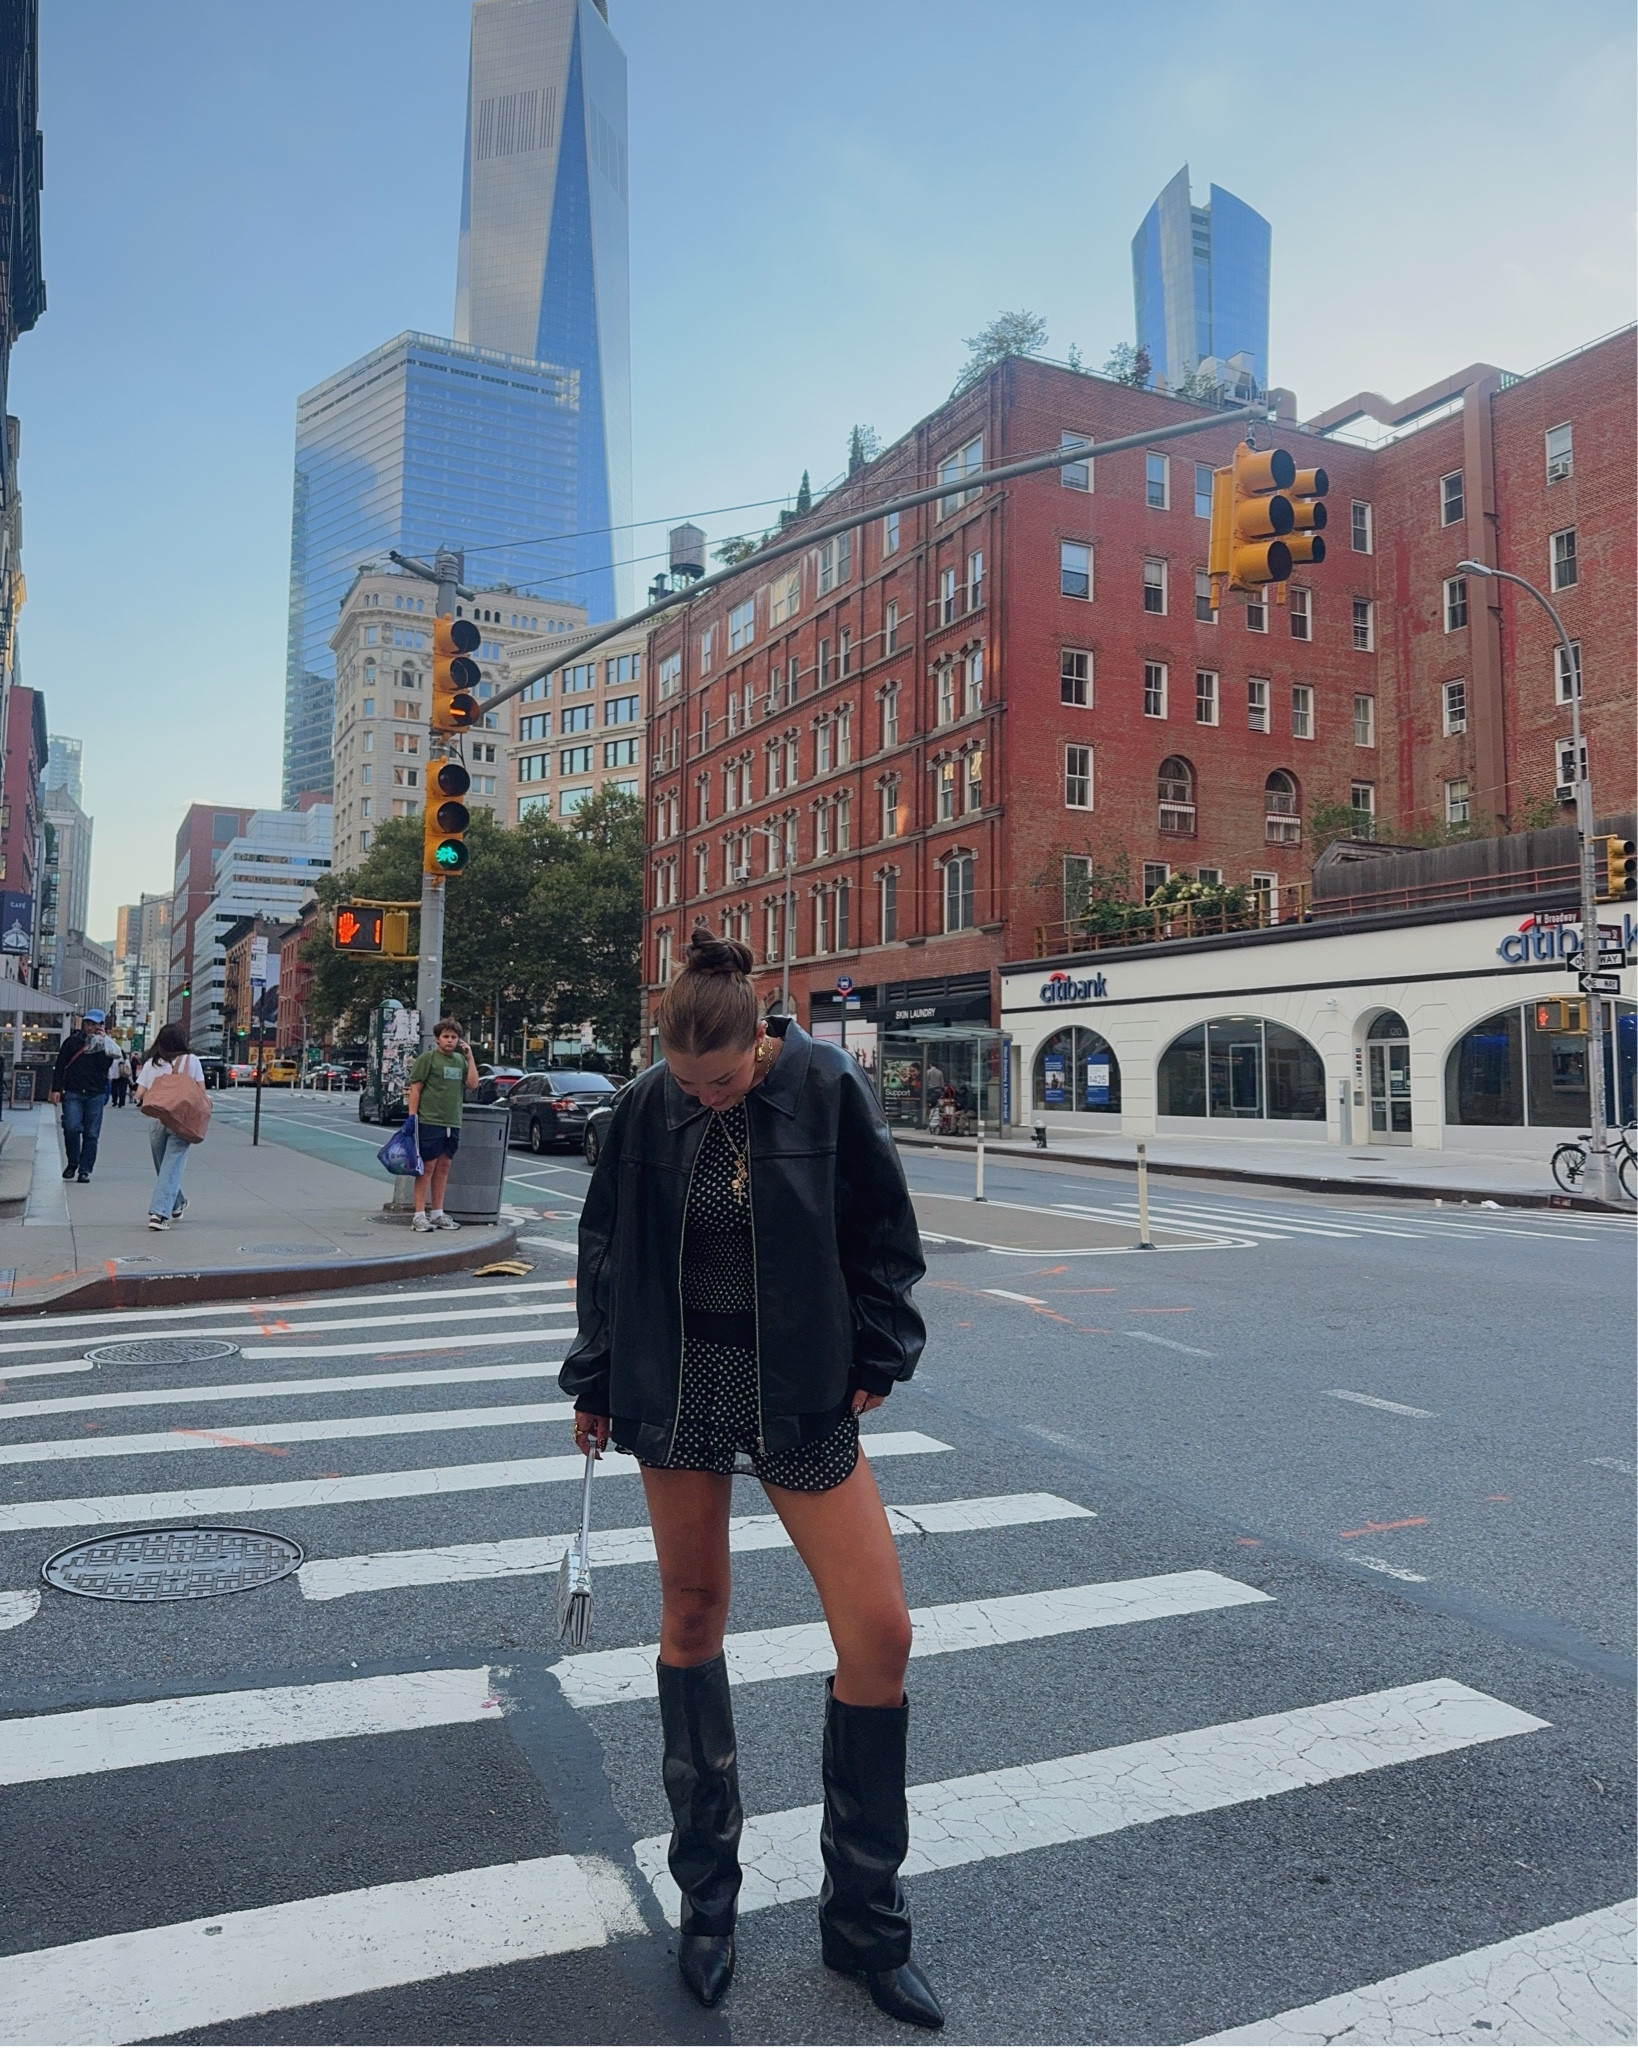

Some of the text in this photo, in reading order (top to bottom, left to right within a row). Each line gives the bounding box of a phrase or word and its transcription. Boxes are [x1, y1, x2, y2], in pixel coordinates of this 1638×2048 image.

[1535, 912, 1577, 924] W Broadway
[1500, 913, 1637, 963] citibk
[1575, 955, 1618, 966] ON WAY
[1040, 972, 1107, 1003] citibank
[1585, 979, 1616, 988] ONE WAY
[896, 1008, 936, 1019] SKIN LAUNDRY
[1390, 1027, 1402, 1036] 120
[885, 1088, 911, 1097] Support
